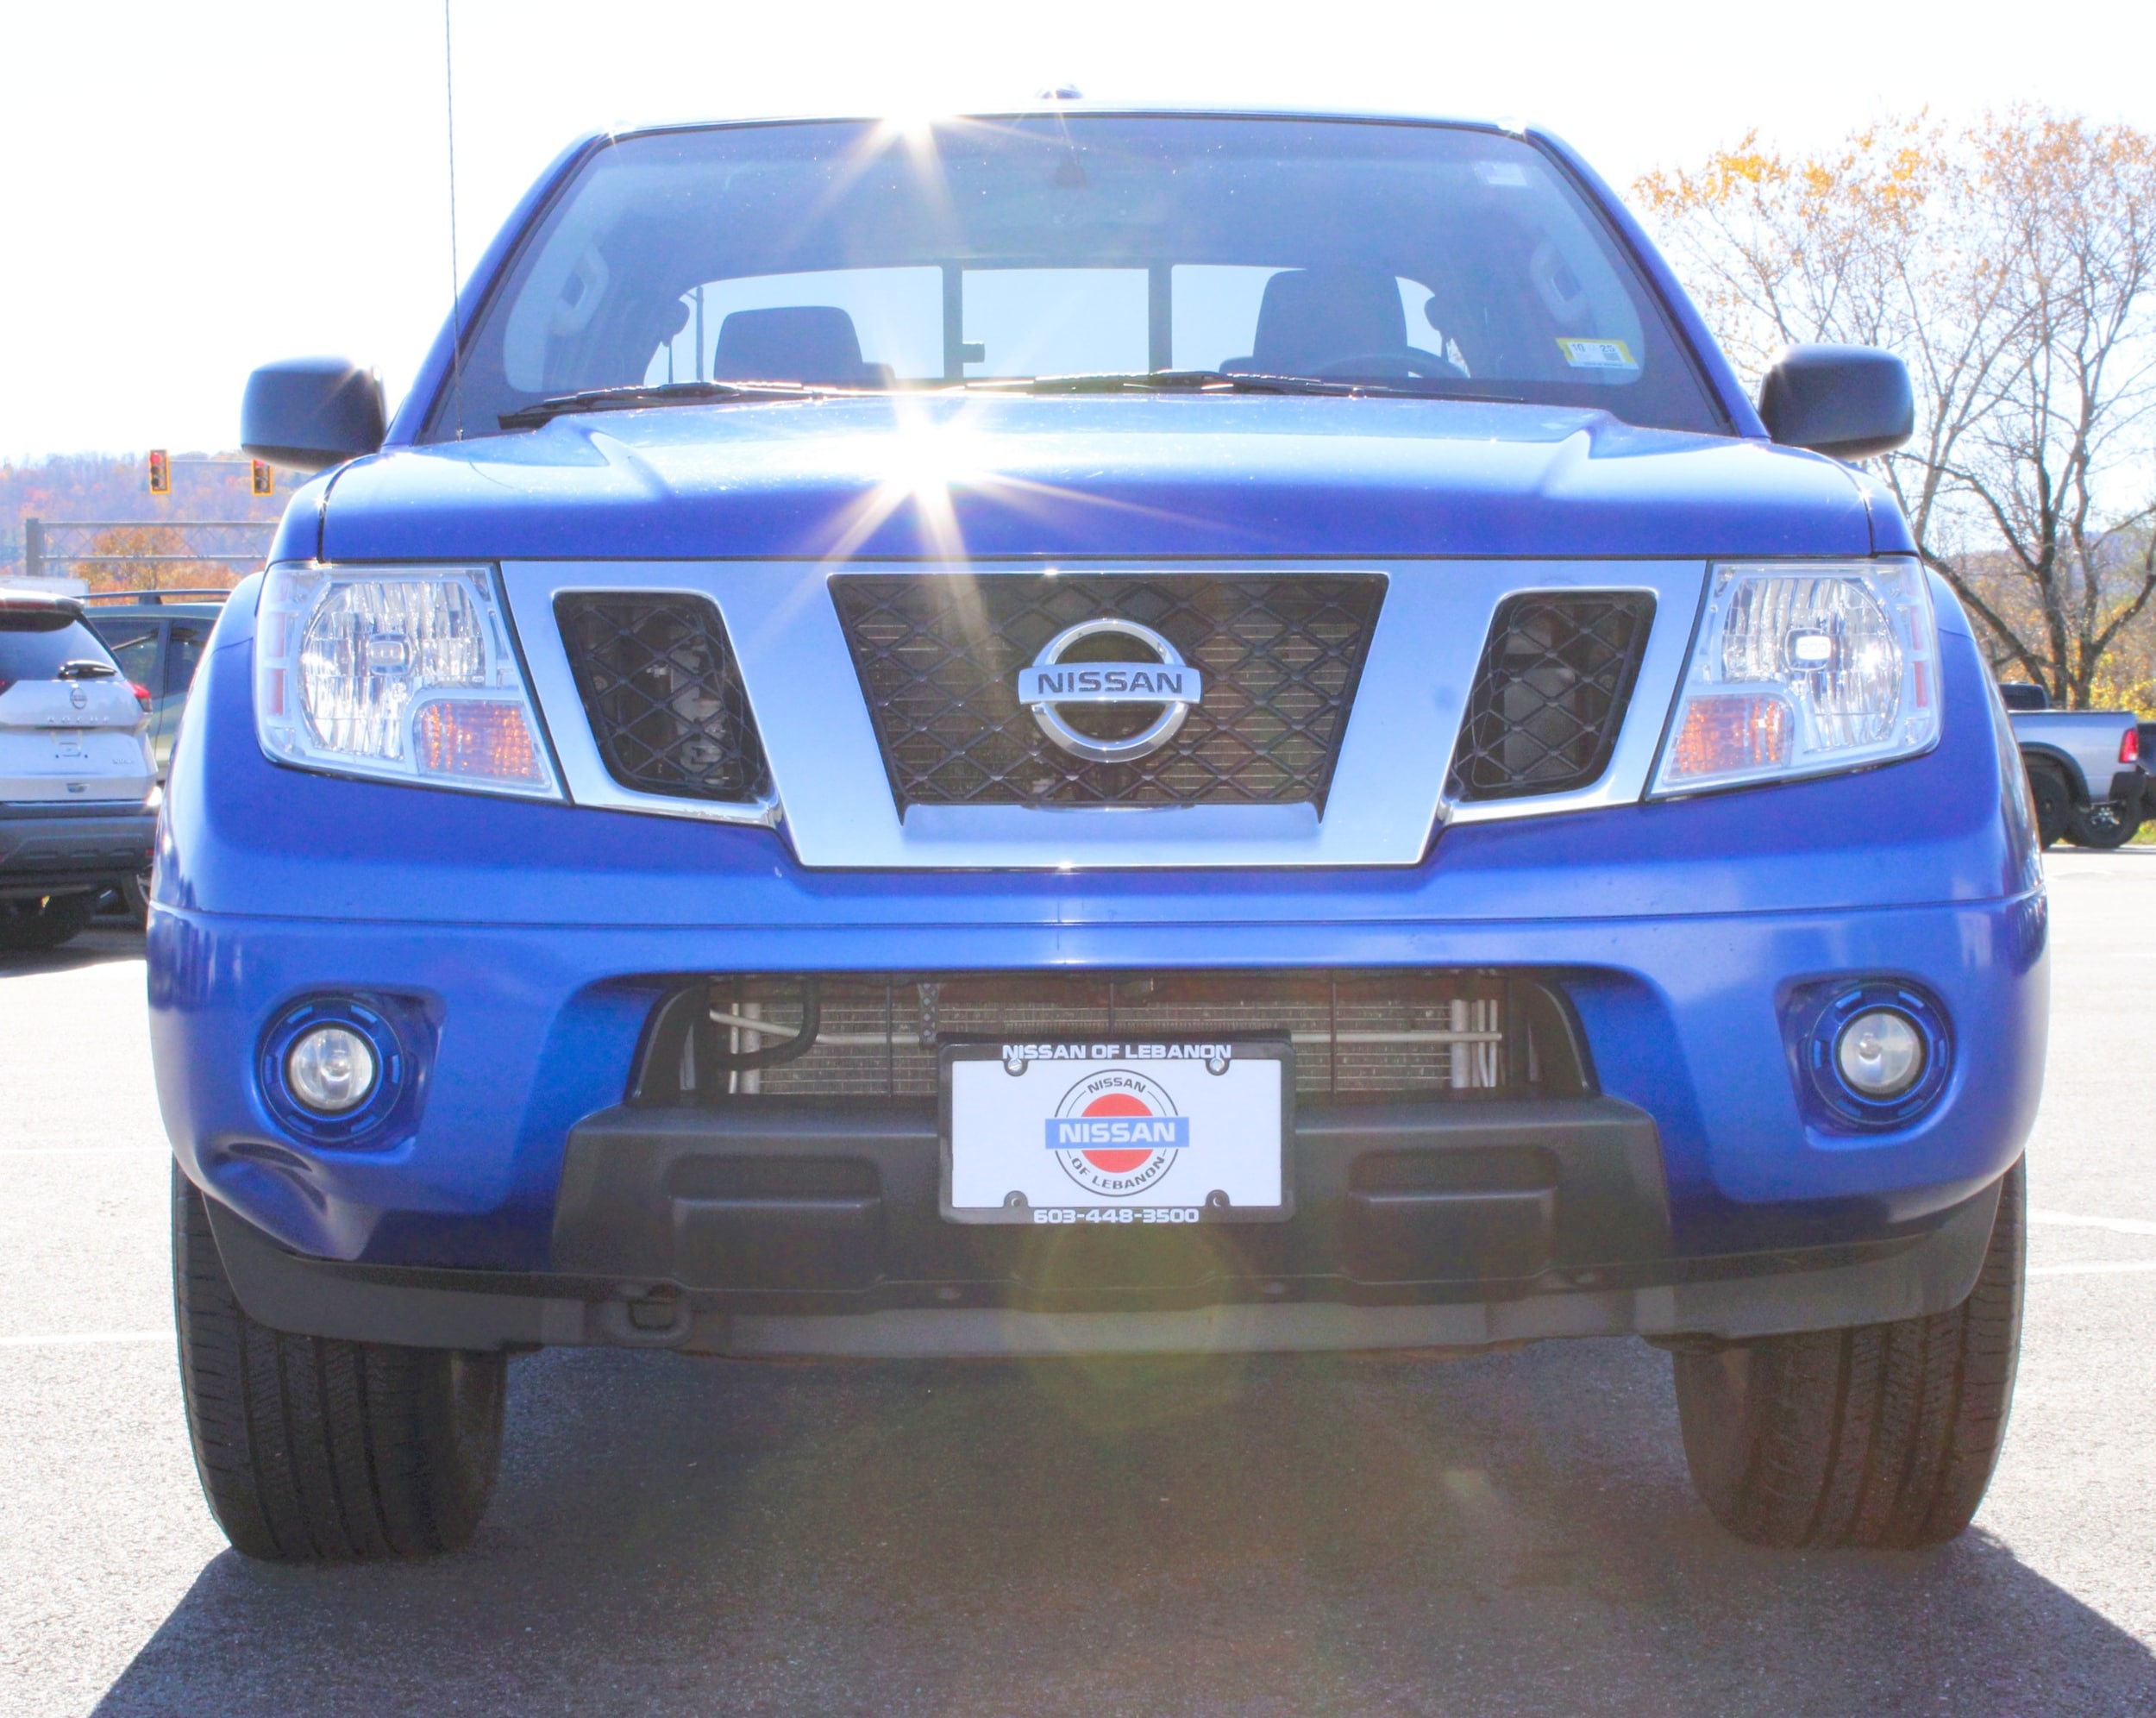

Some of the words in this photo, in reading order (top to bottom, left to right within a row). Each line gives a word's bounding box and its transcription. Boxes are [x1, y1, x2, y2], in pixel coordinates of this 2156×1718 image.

[1038, 671, 1182, 693] NISSAN
[1002, 1044, 1087, 1059] NISSAN
[1091, 1044, 1120, 1059] OF
[1125, 1044, 1232, 1059] LEBANON
[1087, 1076, 1147, 1094] NISSAN
[1058, 1121, 1176, 1144] NISSAN
[1071, 1157, 1090, 1177] OF
[1092, 1156, 1165, 1190] LEBANON
[1033, 1208, 1200, 1224] 603-448-3500
